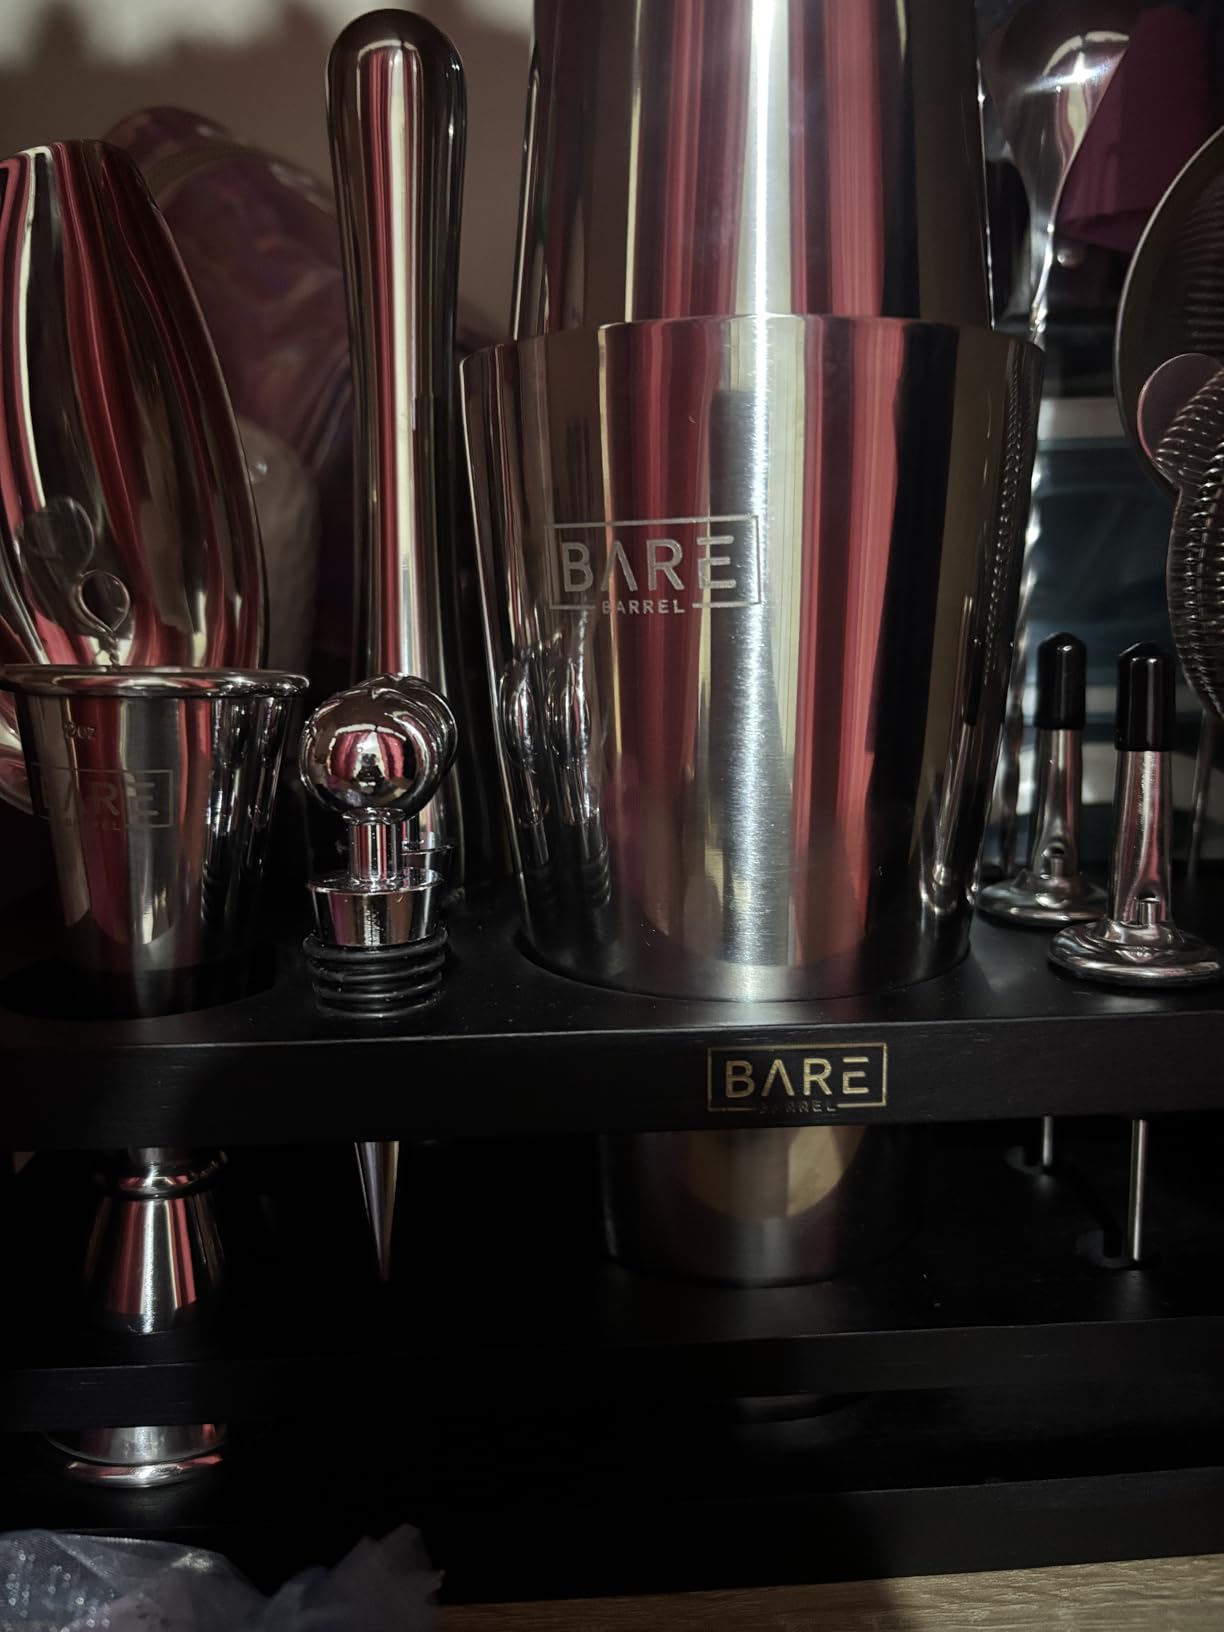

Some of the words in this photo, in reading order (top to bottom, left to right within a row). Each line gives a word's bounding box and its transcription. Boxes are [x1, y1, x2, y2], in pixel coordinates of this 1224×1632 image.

[560, 535, 737, 593] BARE
[602, 599, 686, 615] BARREL
[725, 1056, 870, 1099] BARE
